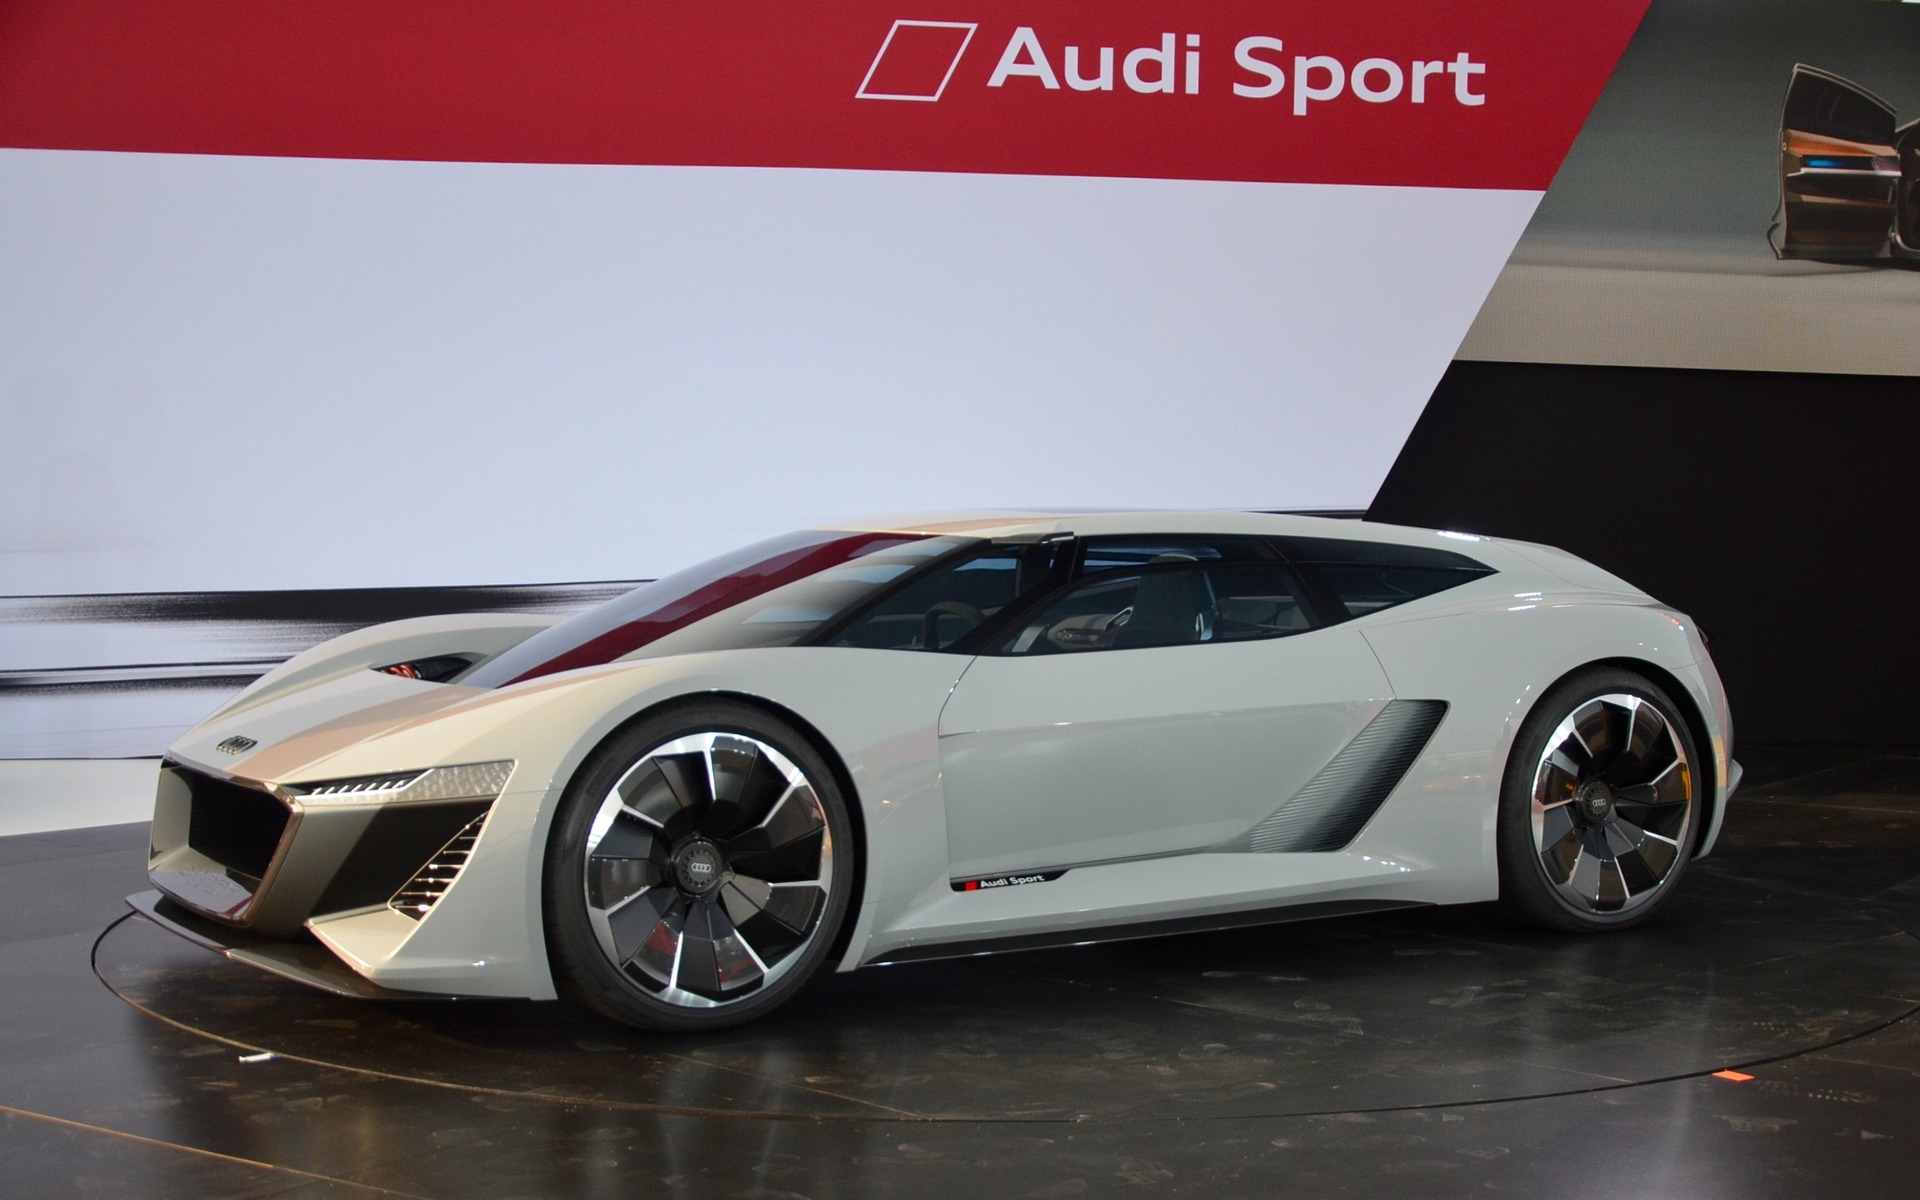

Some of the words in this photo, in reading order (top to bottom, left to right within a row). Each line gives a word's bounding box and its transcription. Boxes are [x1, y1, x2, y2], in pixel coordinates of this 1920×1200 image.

[987, 27, 1200, 95] Audi
[1233, 36, 1486, 116] Sport
[980, 878, 1008, 888] Audi
[1009, 875, 1045, 885] Sport
